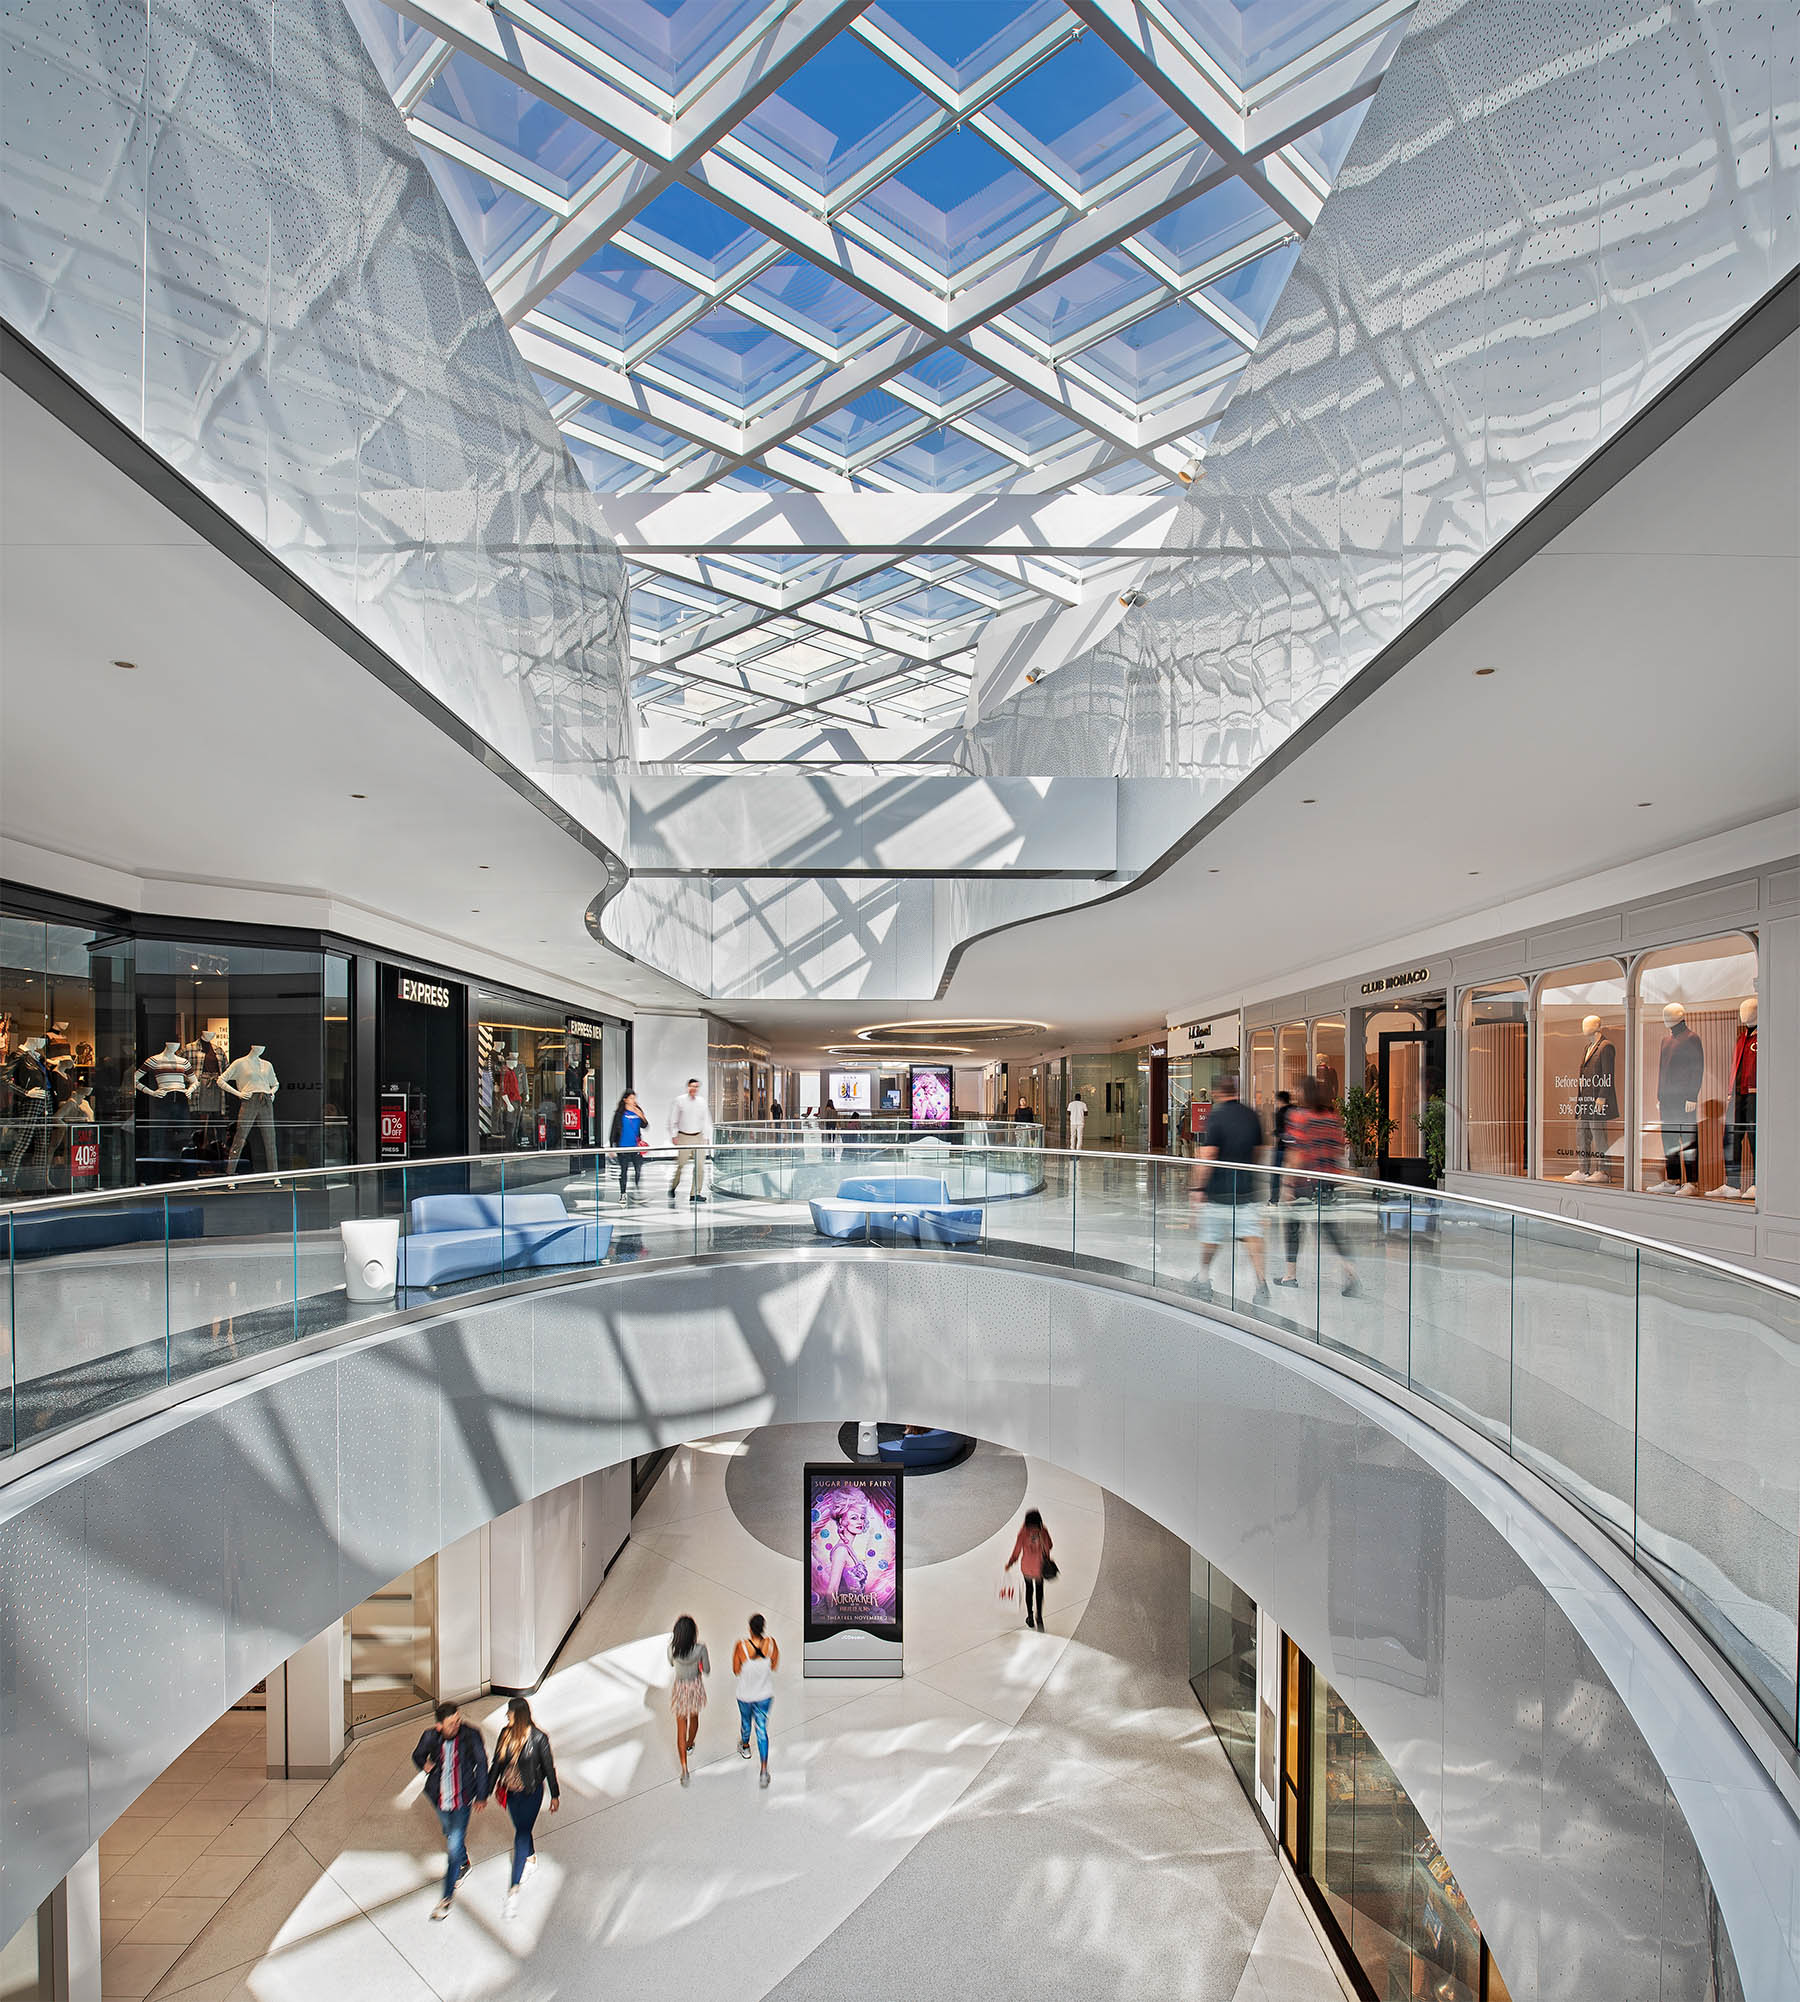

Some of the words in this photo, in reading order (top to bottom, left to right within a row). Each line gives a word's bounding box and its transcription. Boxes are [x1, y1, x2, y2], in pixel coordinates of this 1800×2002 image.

[1361, 981, 1385, 995] CLUB
[1385, 969, 1430, 989] MONACO
[402, 978, 450, 1008] EXPRESS
[570, 1020, 592, 1038] EXPRESS
[1555, 1075, 1578, 1088] Before
[1579, 1074, 1591, 1088] the
[1592, 1073, 1612, 1088] Cold
[1575, 1103, 1588, 1115] OFF
[381, 1117, 403, 1136] 0%
[75, 1145, 97, 1166] 40%
[1556, 1148, 1574, 1156] CLUB
[1575, 1150, 1605, 1159] MONACO
[815, 1480, 841, 1488] SUGAR
[843, 1480, 867, 1488] PLUM
[869, 1480, 893, 1488] FAIRY
[830, 1590, 879, 1607] NUTCRACKER
